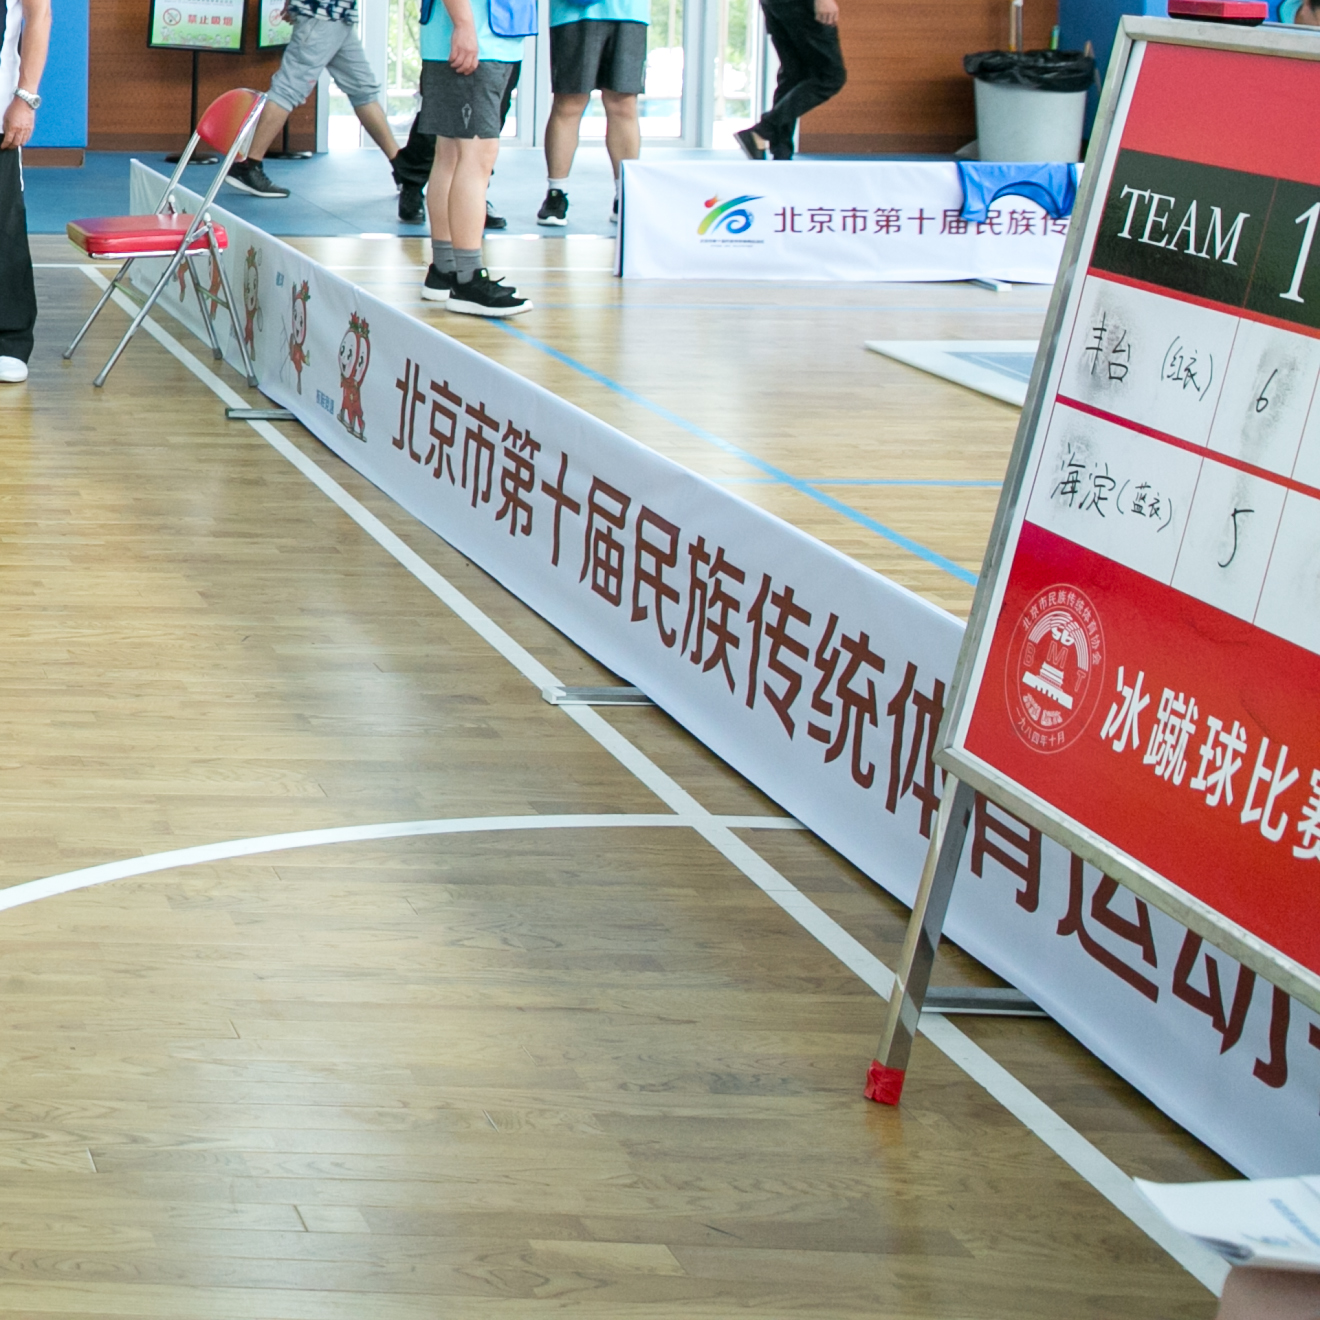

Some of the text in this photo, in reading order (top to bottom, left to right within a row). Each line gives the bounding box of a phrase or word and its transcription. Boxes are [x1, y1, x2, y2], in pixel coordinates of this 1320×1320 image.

[1117, 184, 1251, 266] TEAM
[1085, 311, 1131, 383] 丰台
[1255, 368, 1279, 414] 6
[1217, 507, 1255, 568] 5
[1022, 591, 1102, 666] 北京市民族传统体育协会
